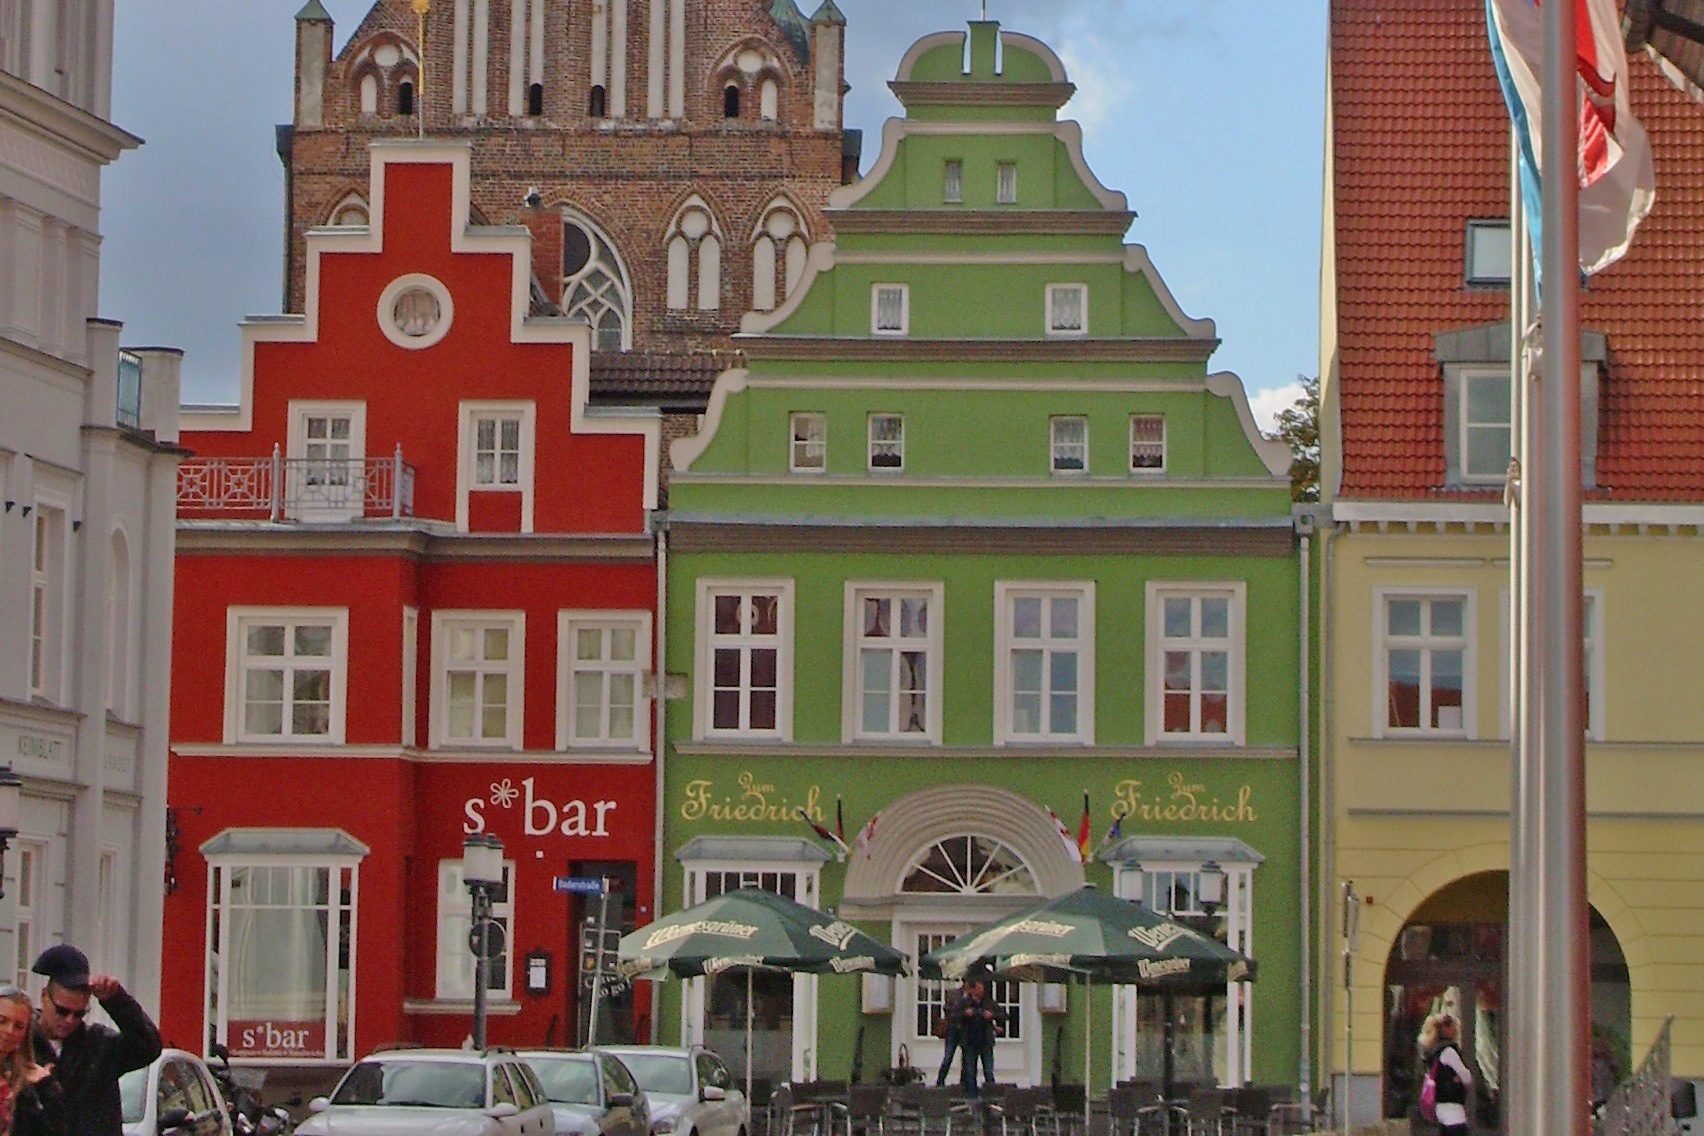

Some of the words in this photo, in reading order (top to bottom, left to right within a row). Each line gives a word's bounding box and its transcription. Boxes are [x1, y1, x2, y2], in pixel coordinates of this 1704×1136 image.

[738, 772, 775, 794] Zum
[1168, 771, 1206, 794] Zum
[681, 780, 826, 821] Friedrich
[1110, 779, 1258, 821] Friedrich
